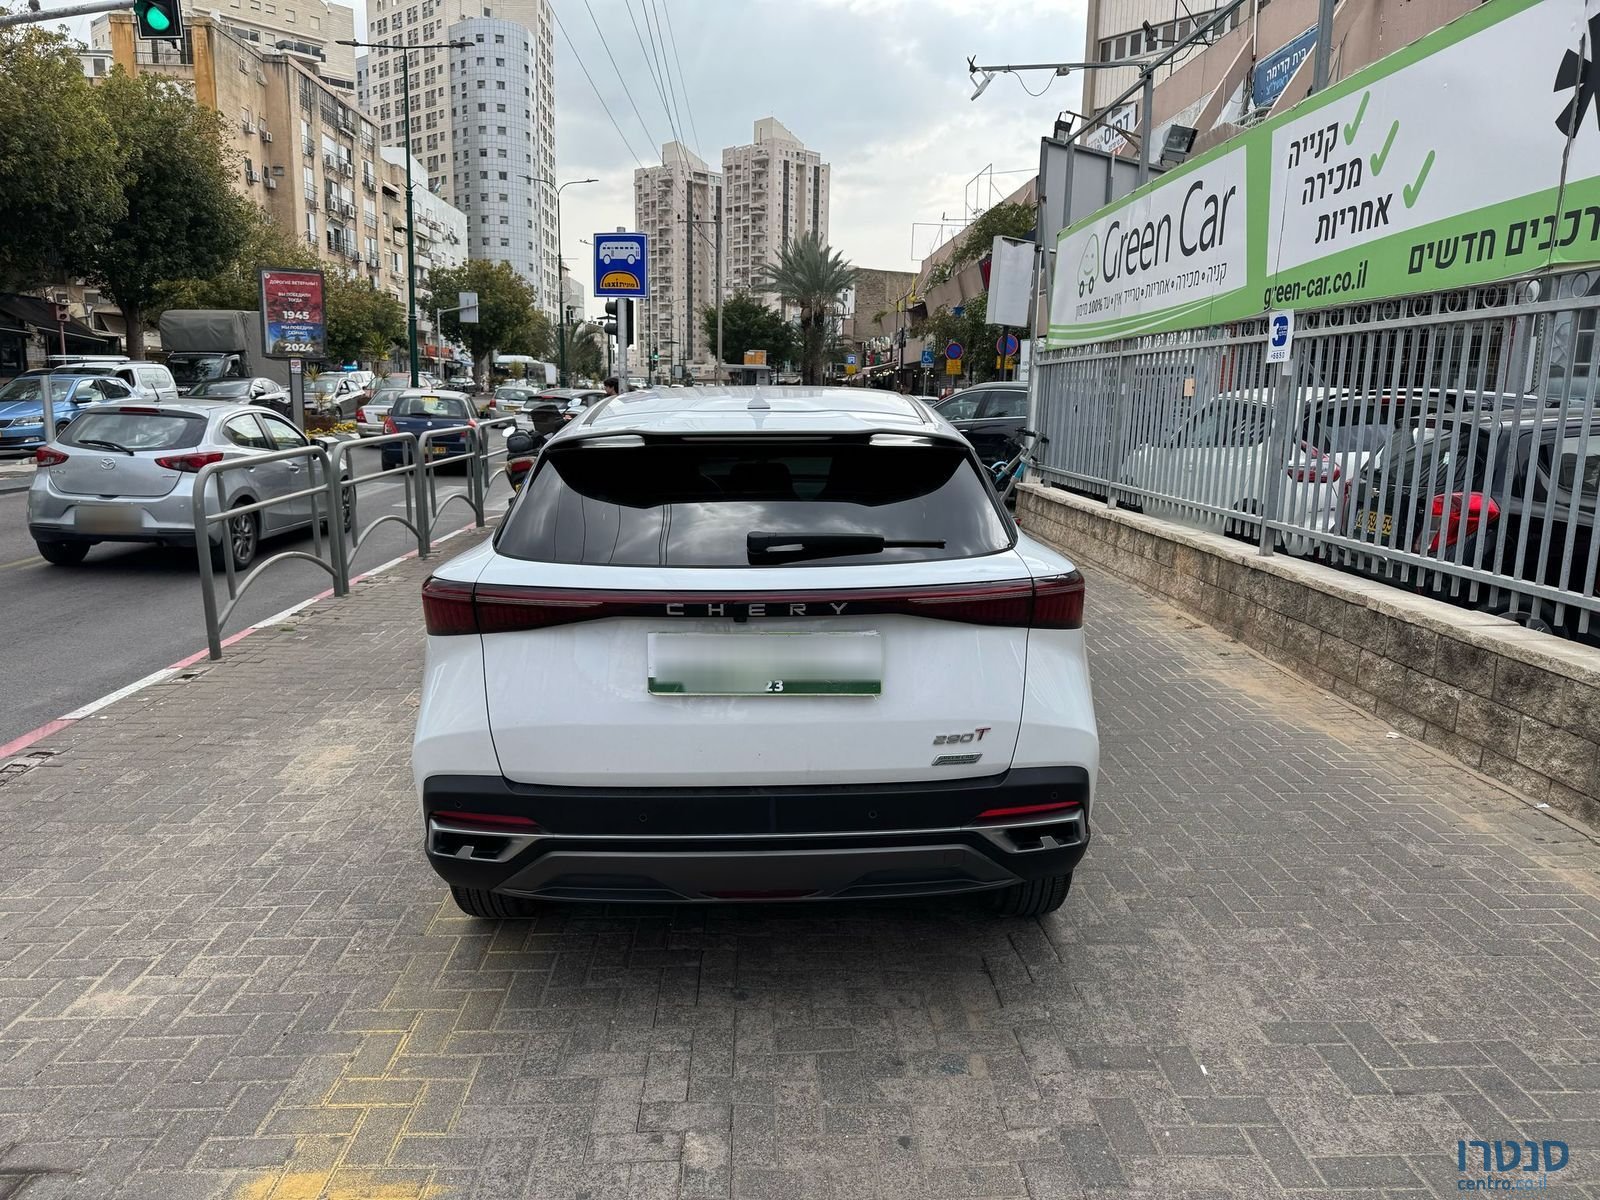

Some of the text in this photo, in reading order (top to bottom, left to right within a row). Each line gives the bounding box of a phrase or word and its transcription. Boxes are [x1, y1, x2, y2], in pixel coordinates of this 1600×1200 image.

[1266, 57, 1291, 81] קדימה
[1287, 122, 1339, 170] קנייה
[1301, 157, 1363, 206] מכירה
[1314, 193, 1394, 244] אחריות
[1102, 180, 1237, 283] Green Car
[1408, 228, 1497, 275] חדשים
[1175, 270, 1200, 291] מכירה
[1206, 262, 1228, 286] קניה
[1144, 277, 1171, 299] אחריות
[282, 310, 310, 320] 1945
[1088, 297, 1103, 314] 100%
[284, 343, 314, 352] 2024
[666, 602, 849, 617] CHERY
[764, 679, 785, 693] 23
